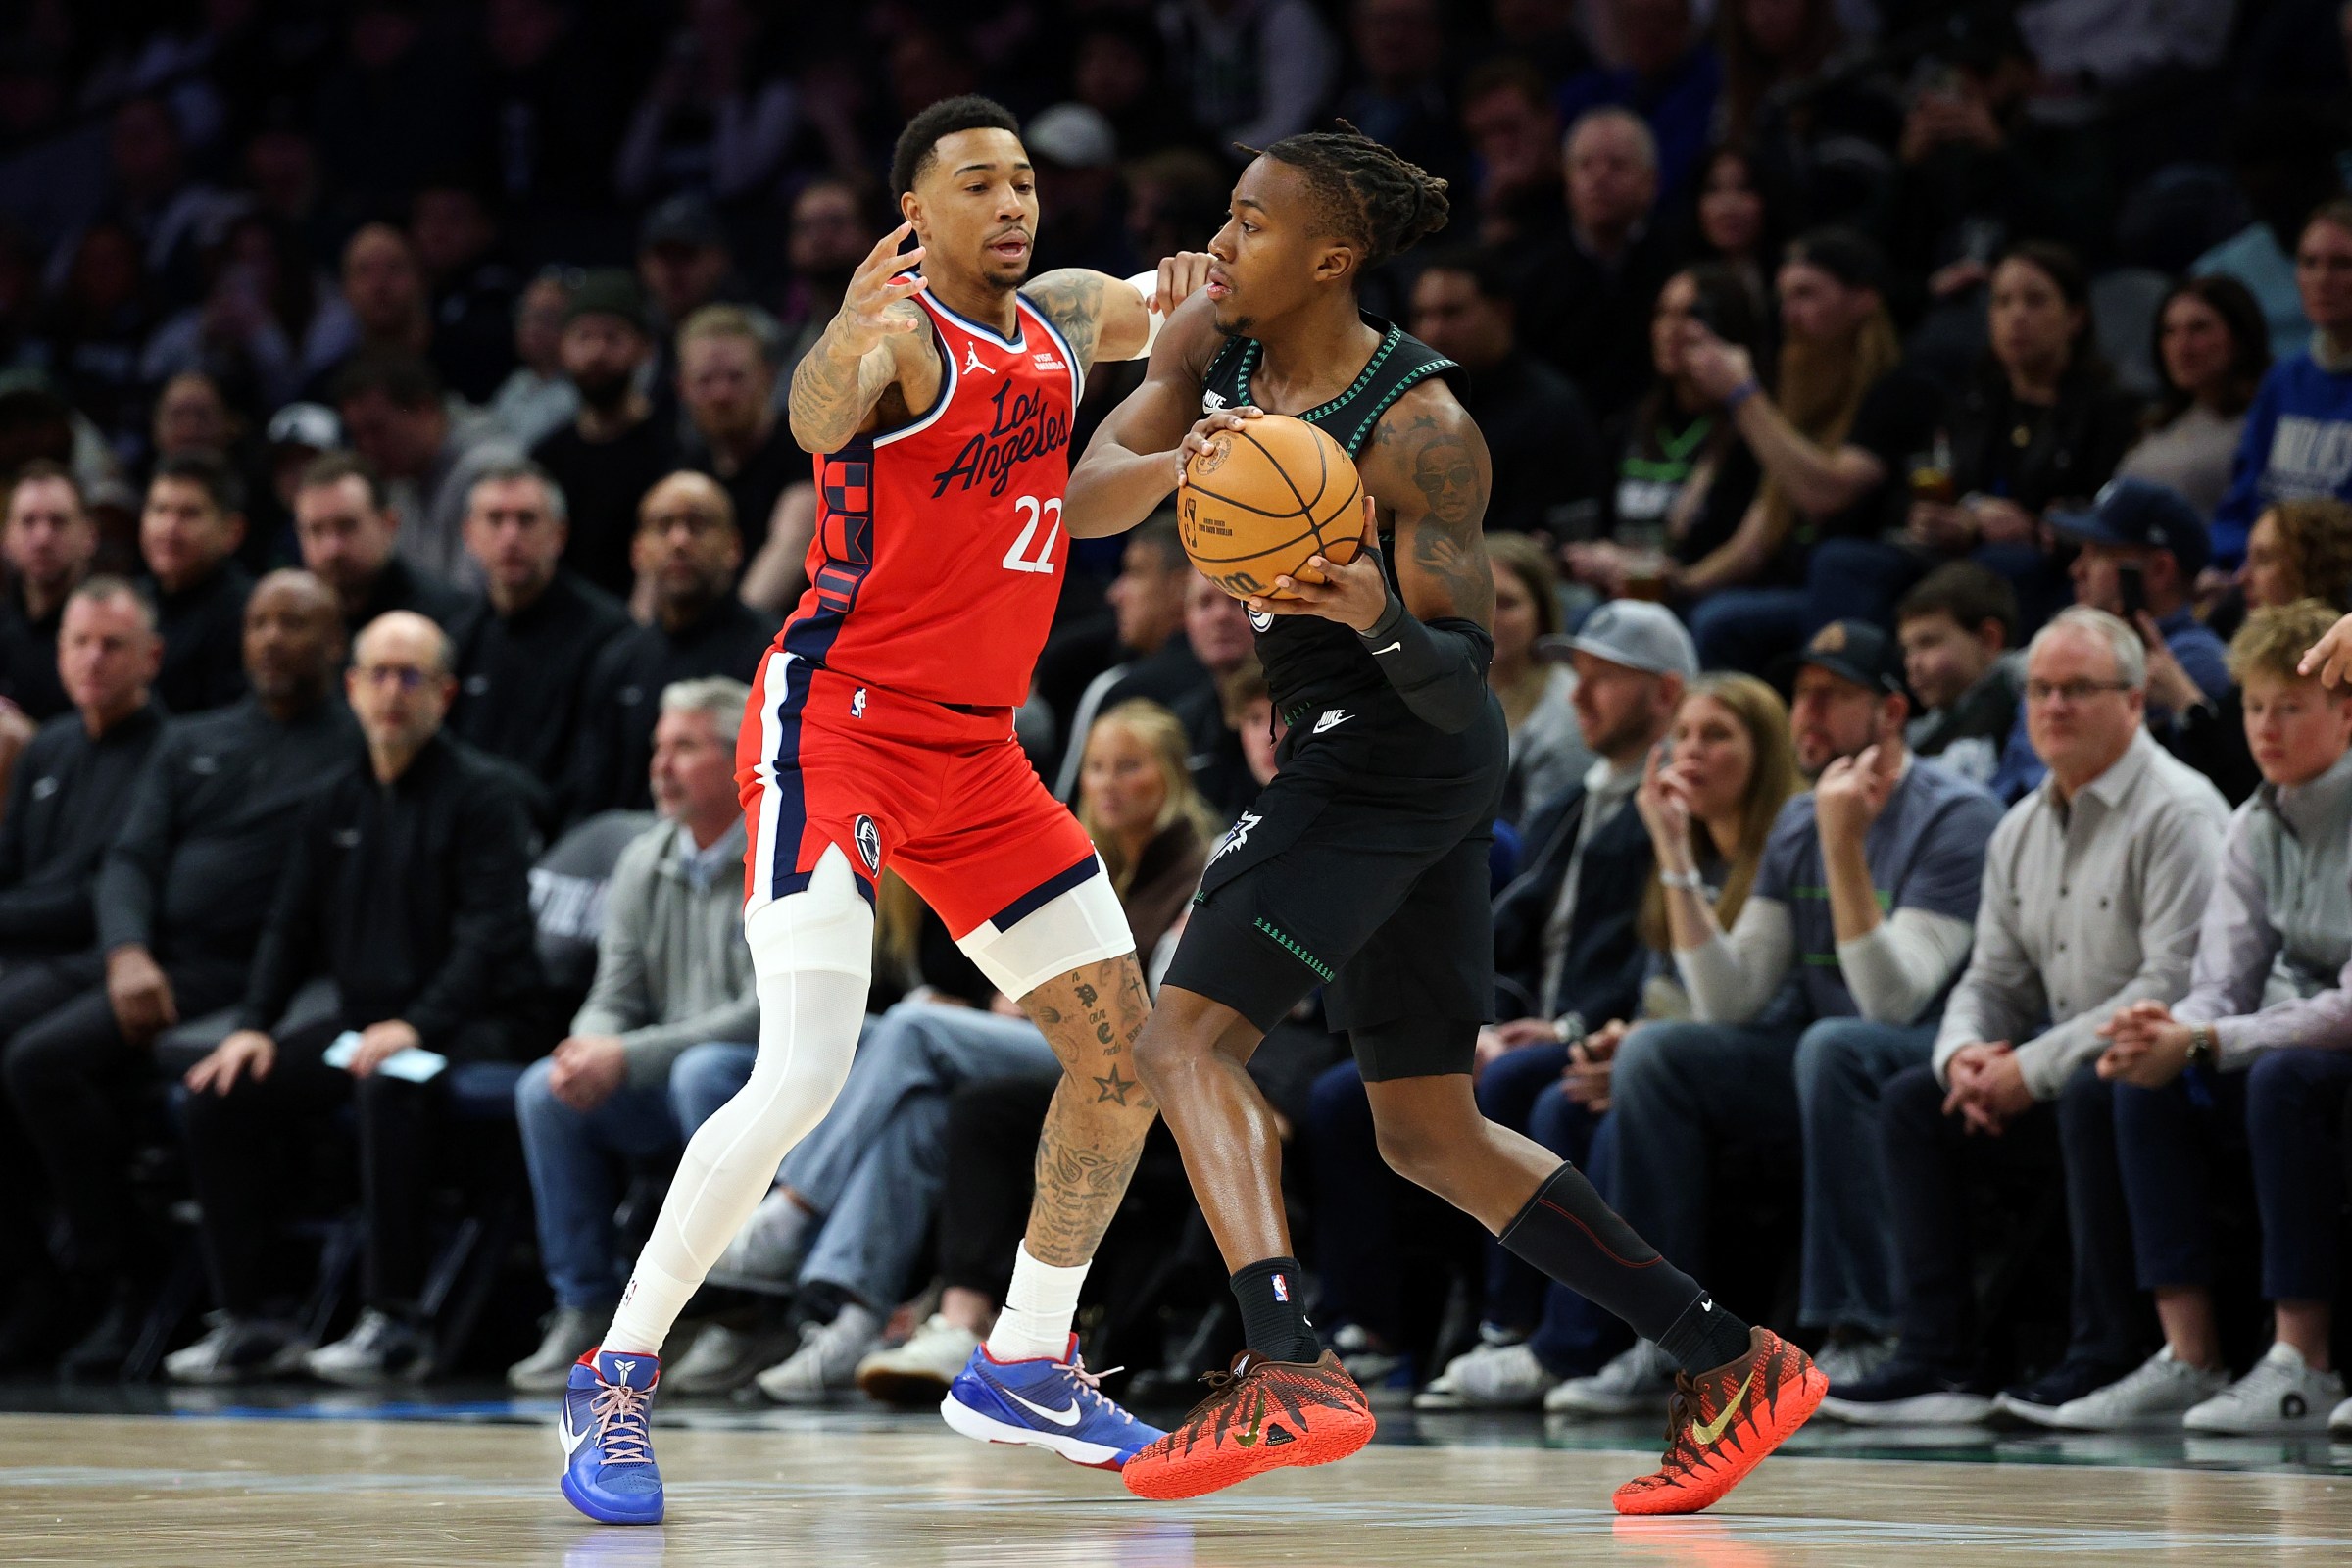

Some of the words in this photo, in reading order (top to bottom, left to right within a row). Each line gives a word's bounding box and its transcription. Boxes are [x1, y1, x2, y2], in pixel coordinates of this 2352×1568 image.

[991, 377, 1042, 439] Los
[1203, 388, 1227, 409] NIKE
[932, 401, 1068, 499] Angeles
[1002, 494, 1063, 574] 22
[1318, 709, 1346, 726] NIKE
